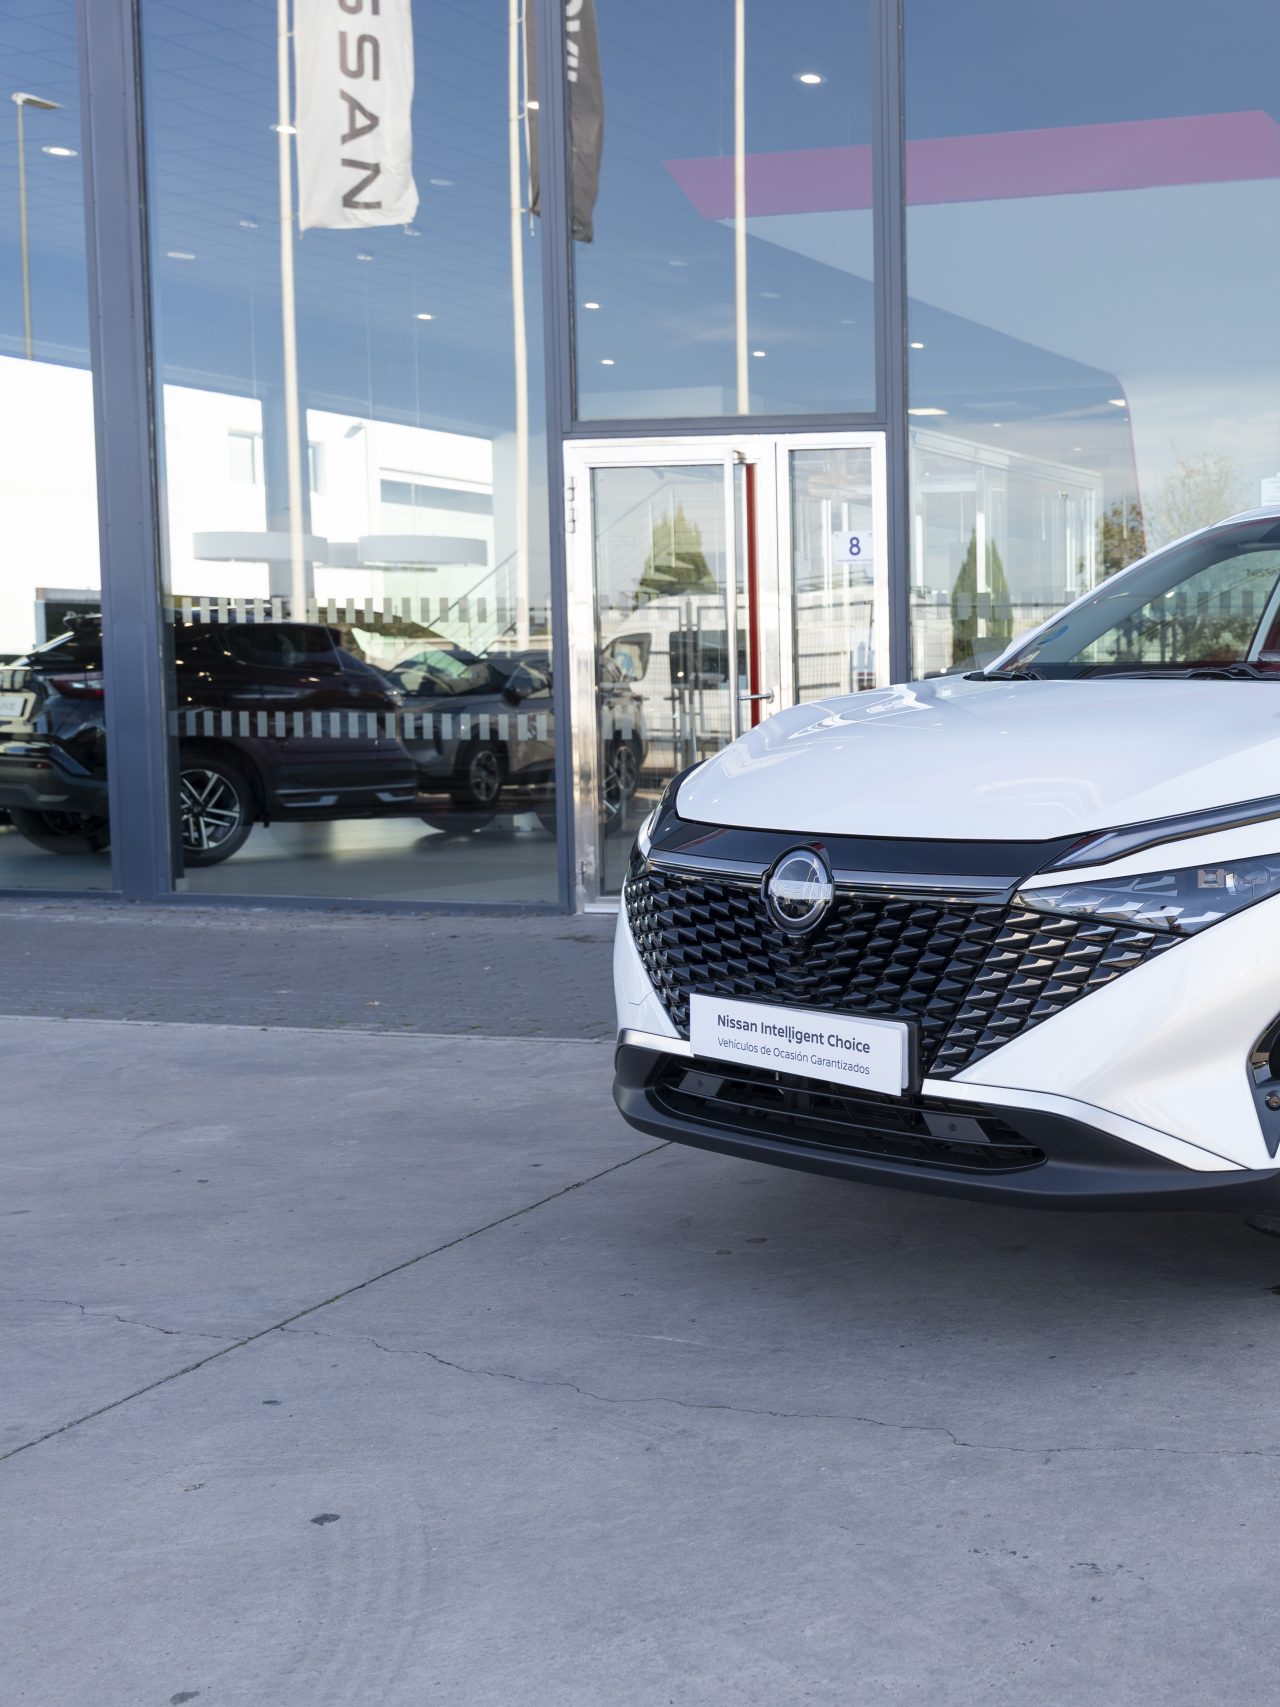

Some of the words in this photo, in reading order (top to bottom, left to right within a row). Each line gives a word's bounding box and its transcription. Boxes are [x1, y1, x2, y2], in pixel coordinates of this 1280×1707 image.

[849, 536, 861, 556] 8
[717, 1014, 758, 1033] Nissan
[761, 1021, 825, 1045] Intelligent
[827, 1034, 871, 1053] Choice
[760, 1045, 771, 1056] de
[773, 1047, 808, 1063] Ocasión
[810, 1054, 870, 1075] Garantizados
